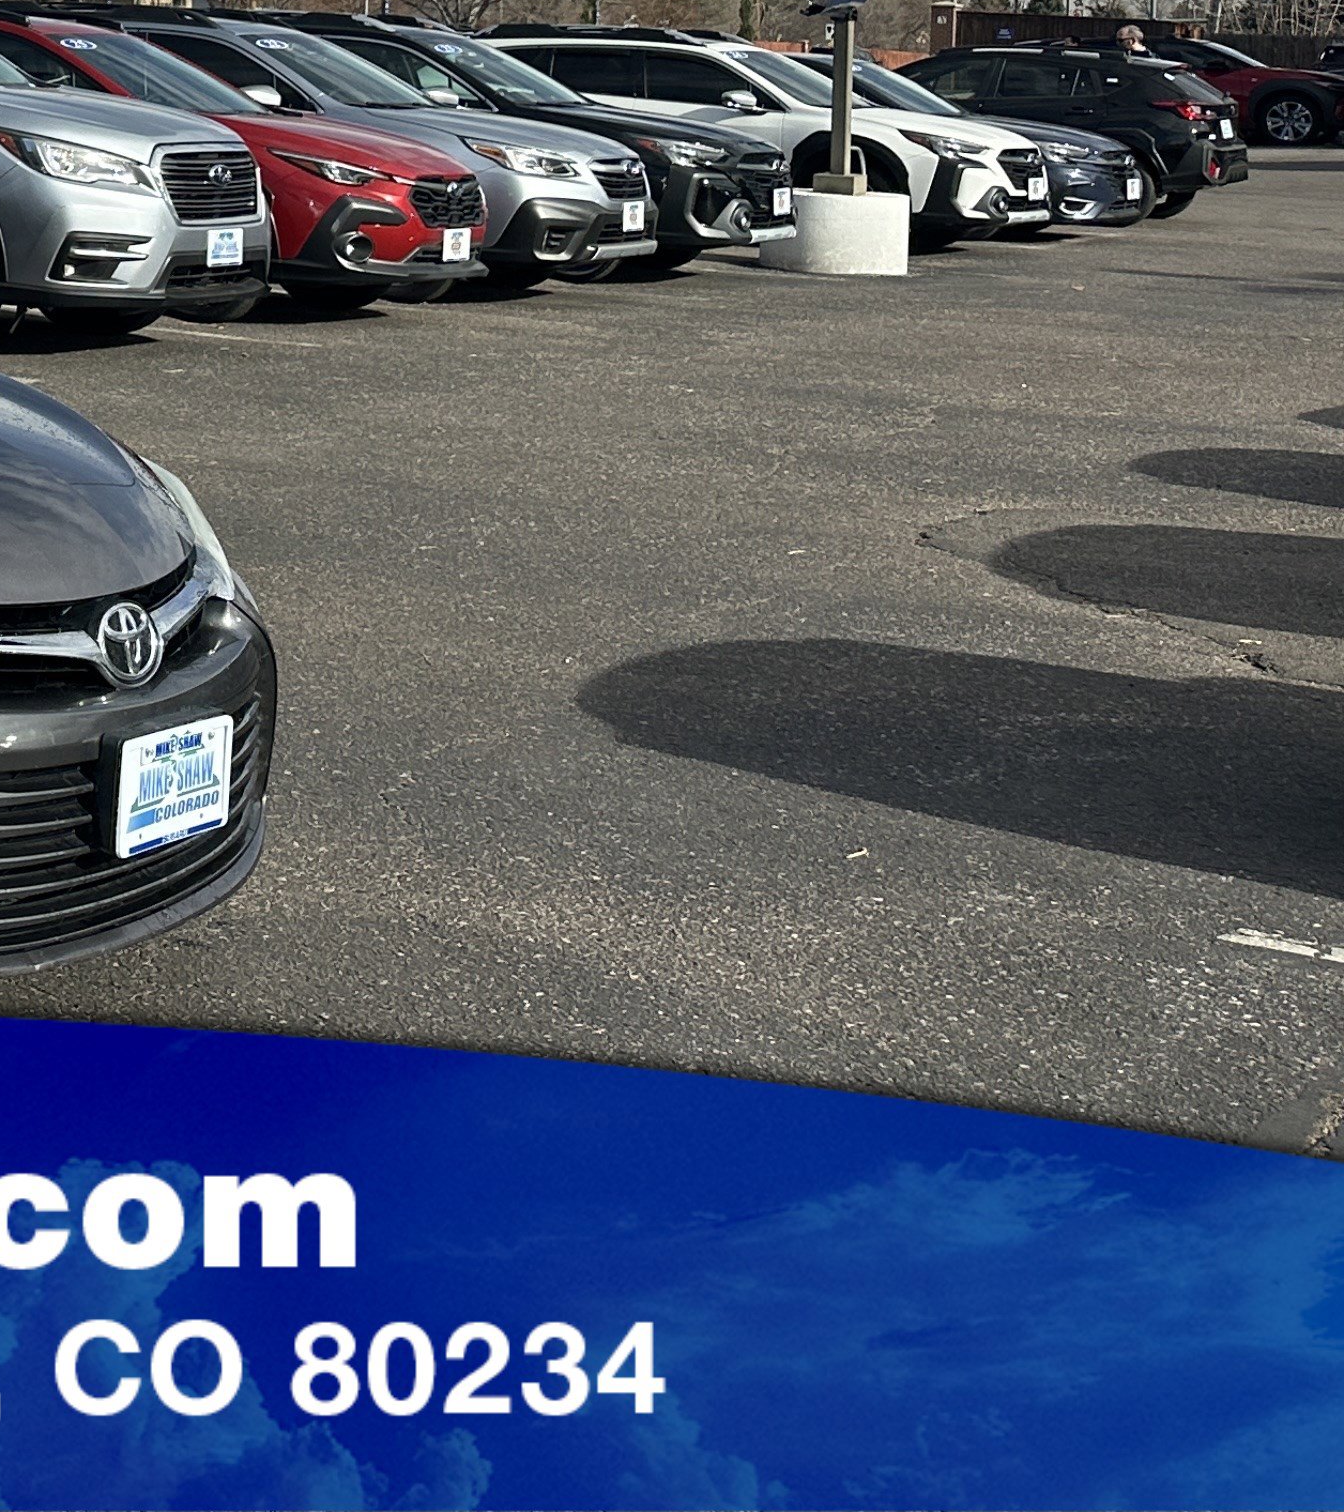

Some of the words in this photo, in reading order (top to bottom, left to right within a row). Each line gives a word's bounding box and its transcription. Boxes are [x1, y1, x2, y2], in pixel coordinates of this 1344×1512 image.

[155, 739, 175, 757] MIKE
[178, 732, 203, 751] SHAW
[139, 766, 170, 803] MIKE
[176, 751, 215, 792] SHAW
[155, 790, 219, 823] COLORADO
